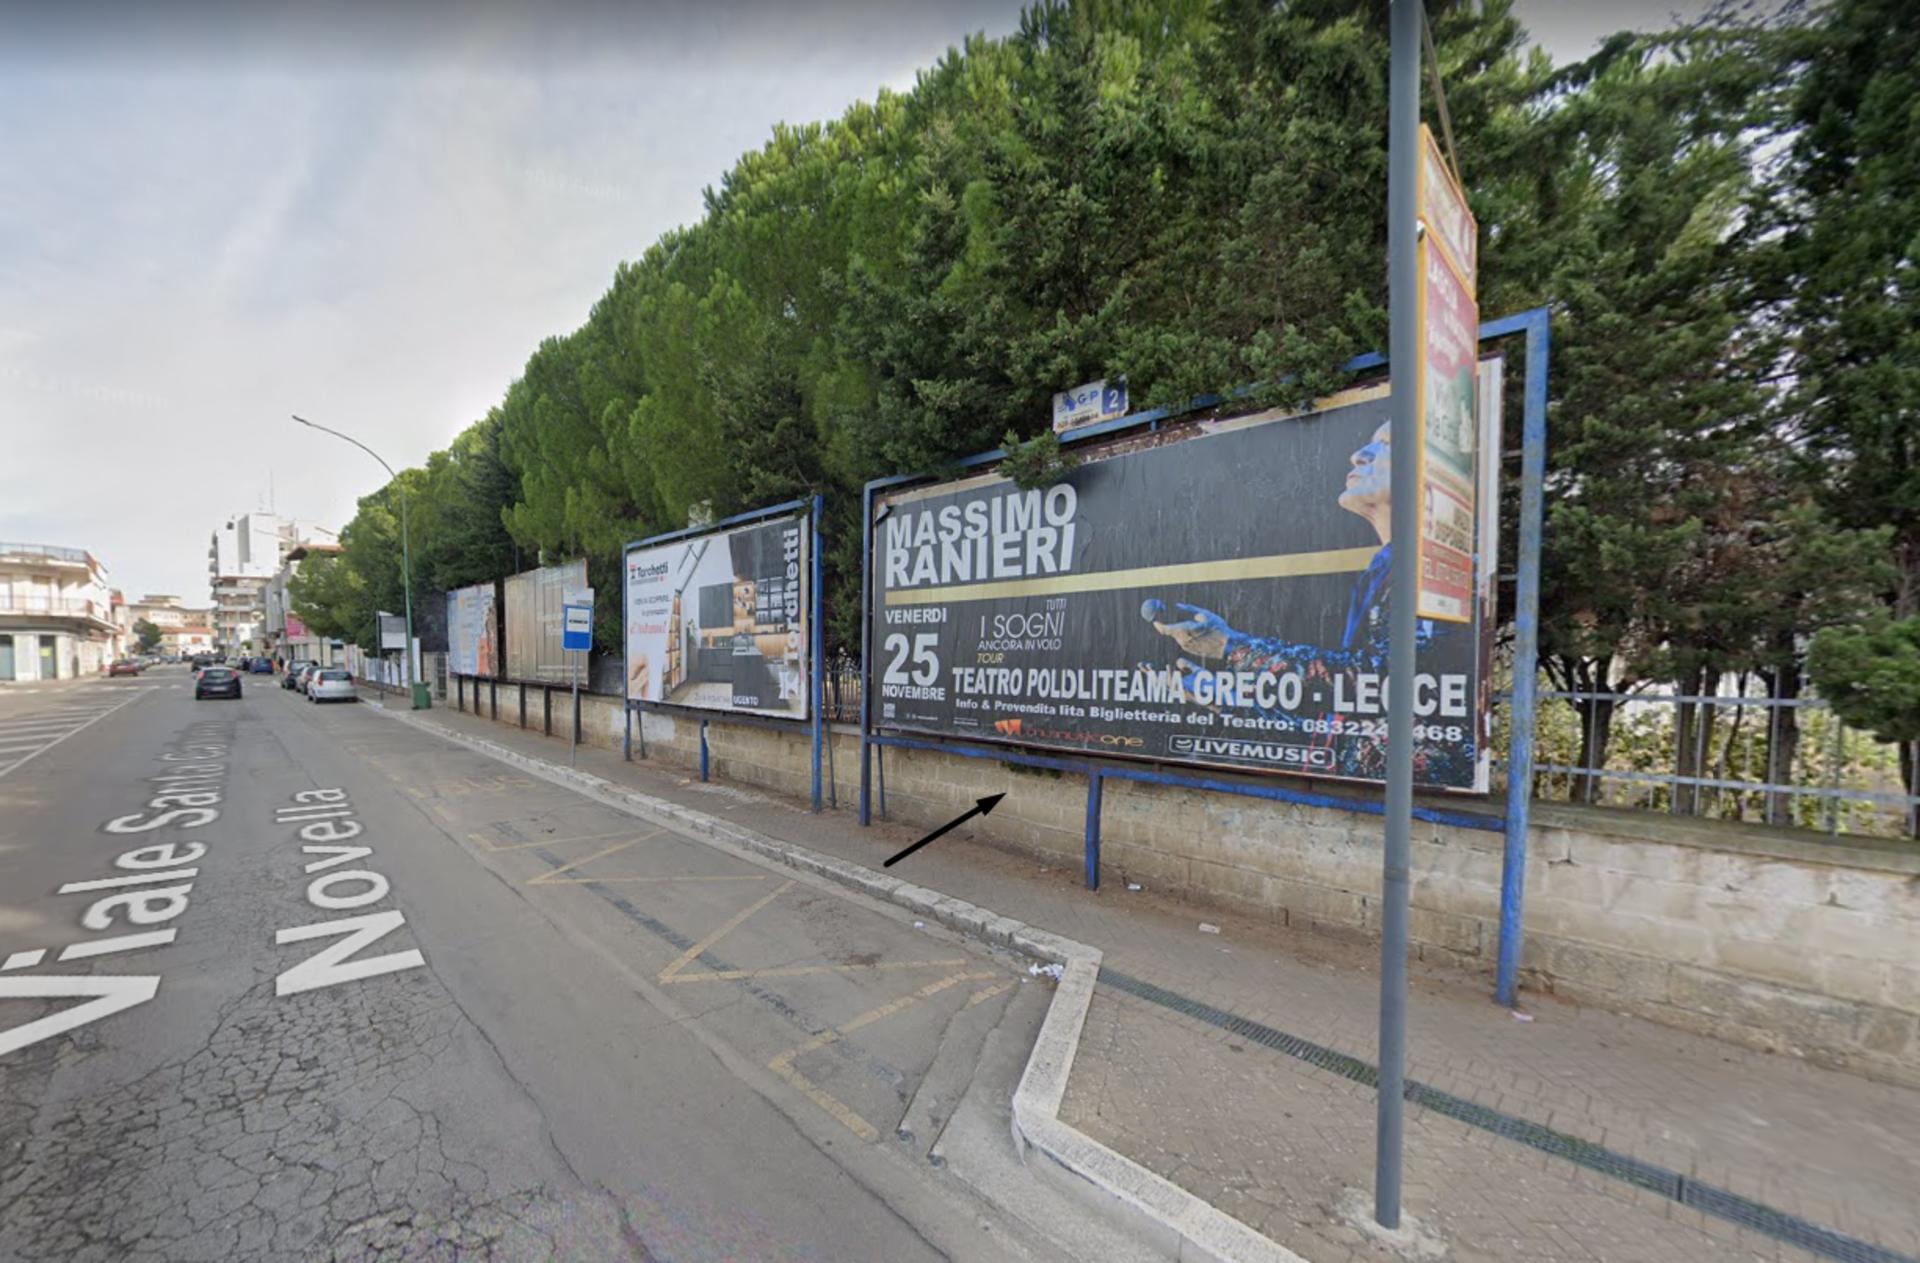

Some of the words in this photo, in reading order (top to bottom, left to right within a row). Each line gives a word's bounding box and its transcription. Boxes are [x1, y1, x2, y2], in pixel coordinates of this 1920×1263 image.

[1108, 389, 1119, 409] 2
[886, 483, 1077, 550] MASSIMO
[885, 523, 1076, 588] RANIERI
[885, 607, 947, 624] VENERDI
[980, 615, 985, 638] I
[993, 610, 1065, 638] SOGNI
[977, 639, 1022, 651] ANCORA
[1036, 638, 1062, 650] VOLO
[977, 652, 1005, 664] TOUR
[883, 633, 940, 687] 25
[882, 685, 946, 701] NOVEMBRE
[952, 667, 1023, 696] TEATRO
[1194, 670, 1302, 710] GRECO
[956, 698, 978, 709] Info
[981, 700, 990, 710] &
[1089, 706, 1181, 723] Biglietteria
[1187, 711, 1213, 725] del
[1220, 713, 1295, 731] Teatro:
